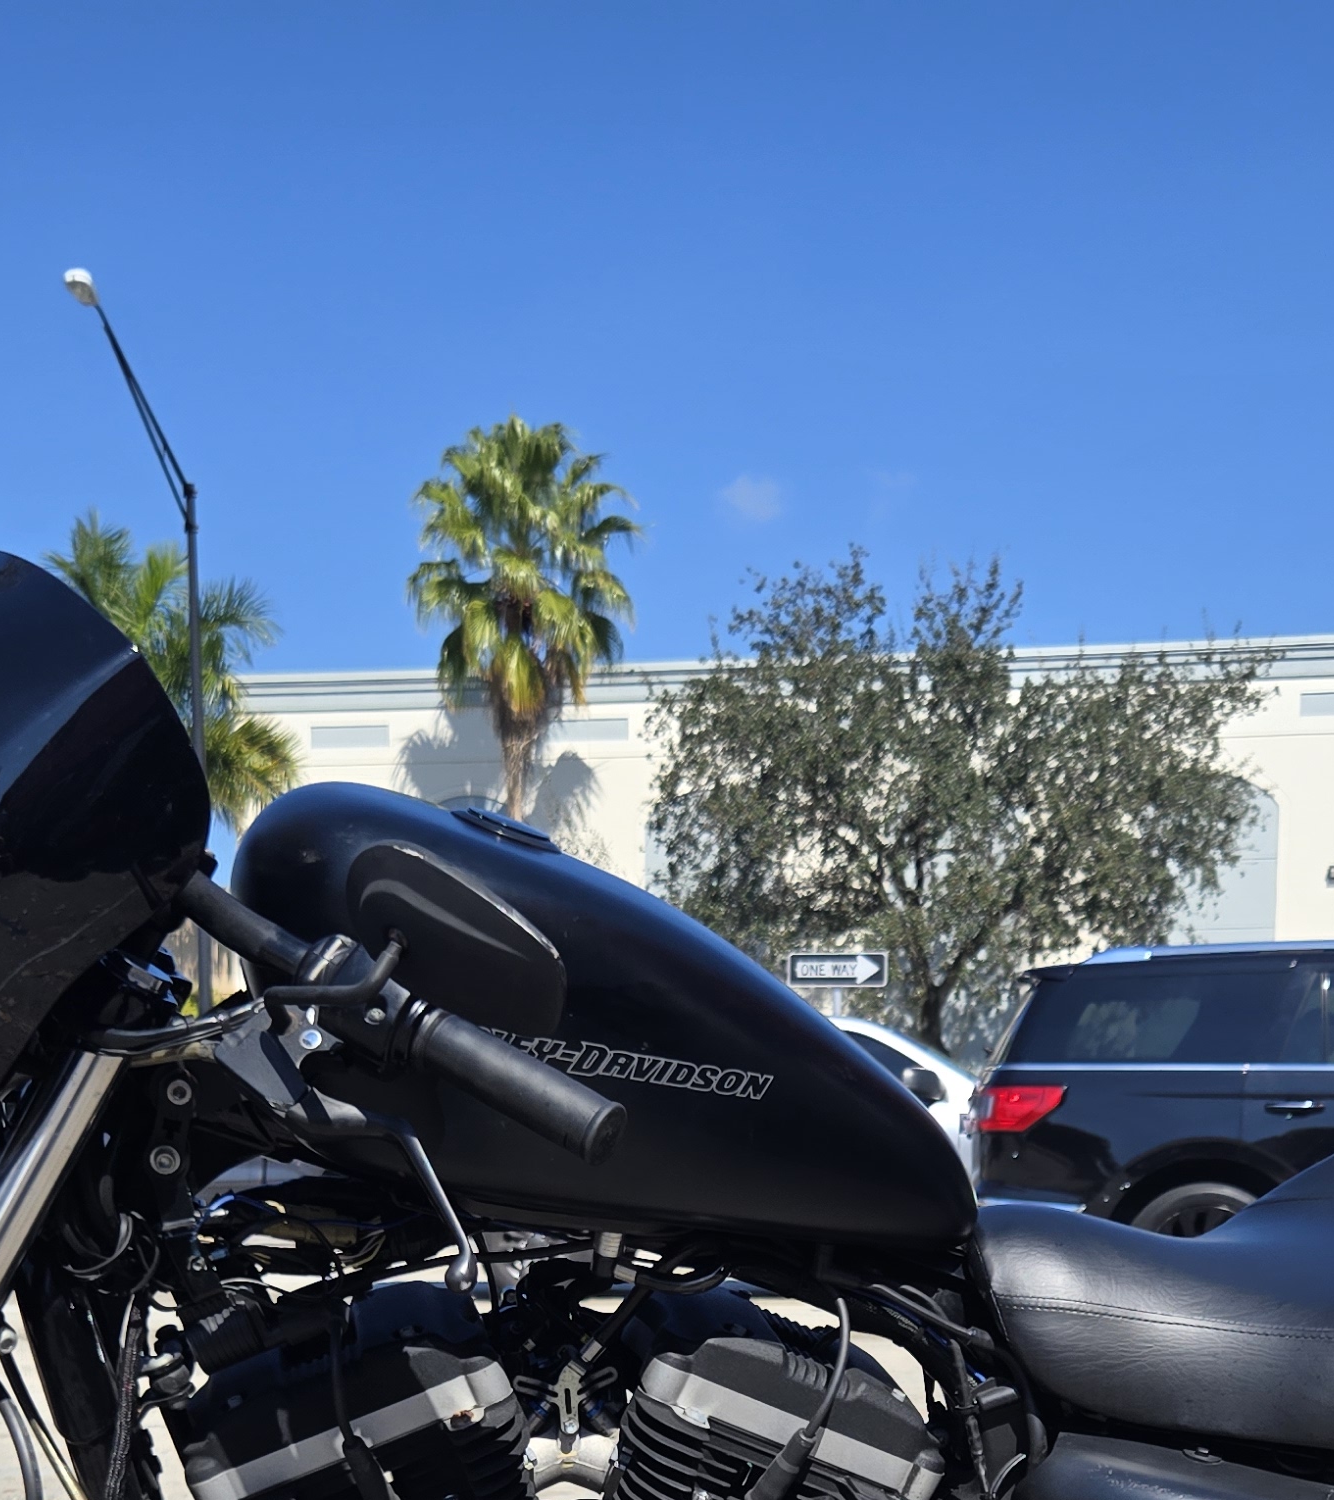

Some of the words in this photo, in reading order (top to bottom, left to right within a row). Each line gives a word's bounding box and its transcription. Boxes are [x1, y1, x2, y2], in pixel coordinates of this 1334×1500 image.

[800, 963, 826, 977] ONE
[831, 963, 857, 977] WAY
[478, 1025, 774, 1101] EY-DAVIDSON
